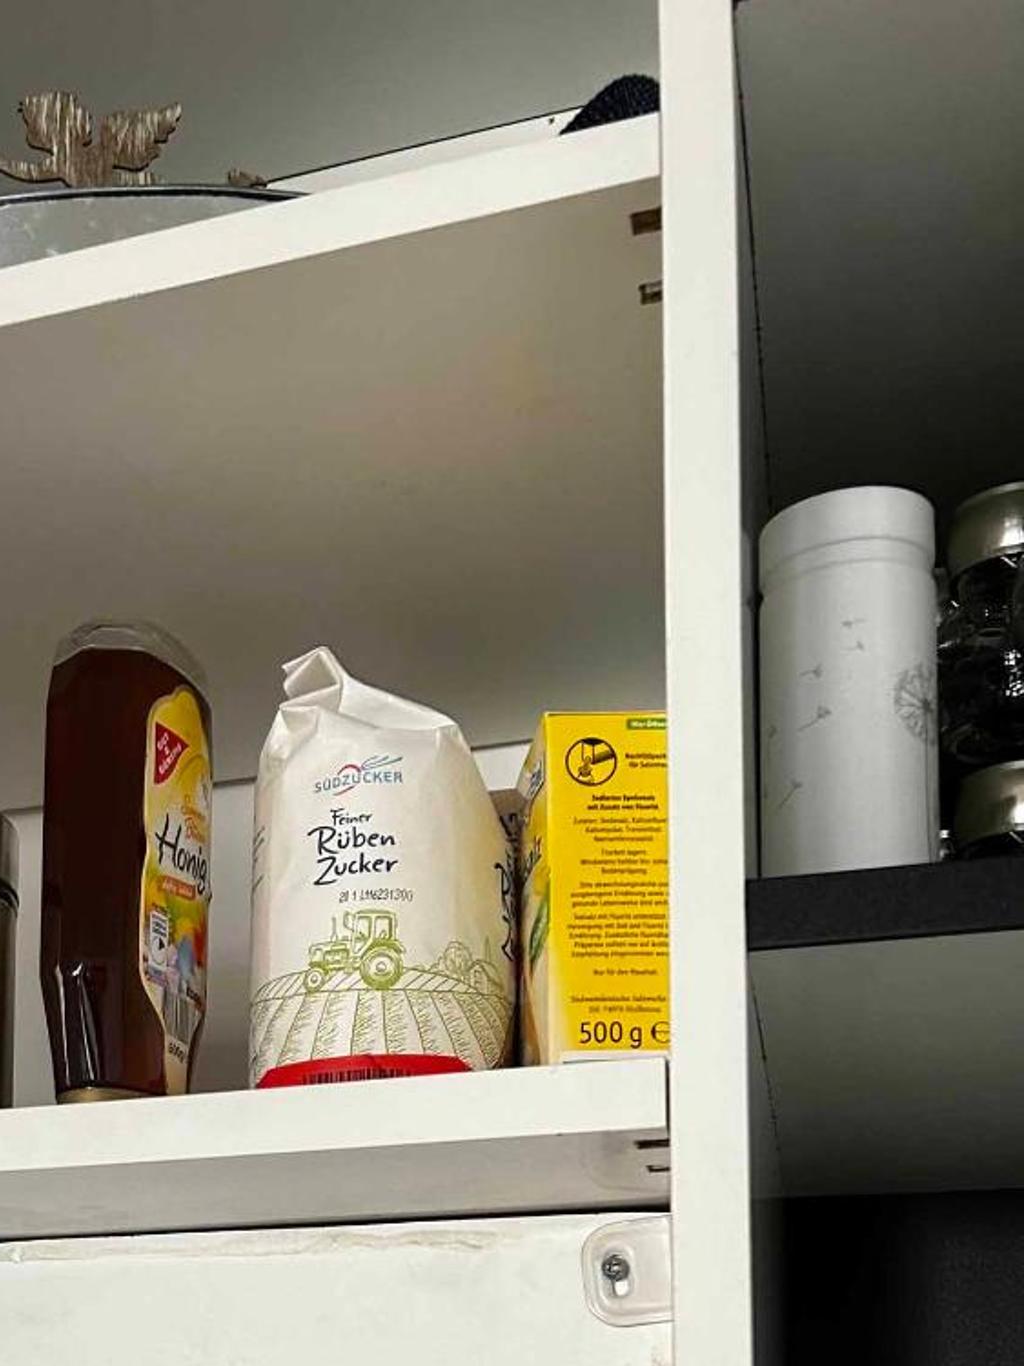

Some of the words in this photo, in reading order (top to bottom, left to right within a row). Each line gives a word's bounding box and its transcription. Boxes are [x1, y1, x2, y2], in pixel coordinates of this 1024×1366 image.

[314, 771, 403, 793] SÜDZUCKER
[330, 808, 373, 826] Feiner
[155, 812, 208, 894] Honig
[307, 826, 396, 855] Rüben
[313, 852, 399, 886] Zucker
[580, 1021, 623, 1044] 500
[629, 1027, 643, 1049] g
